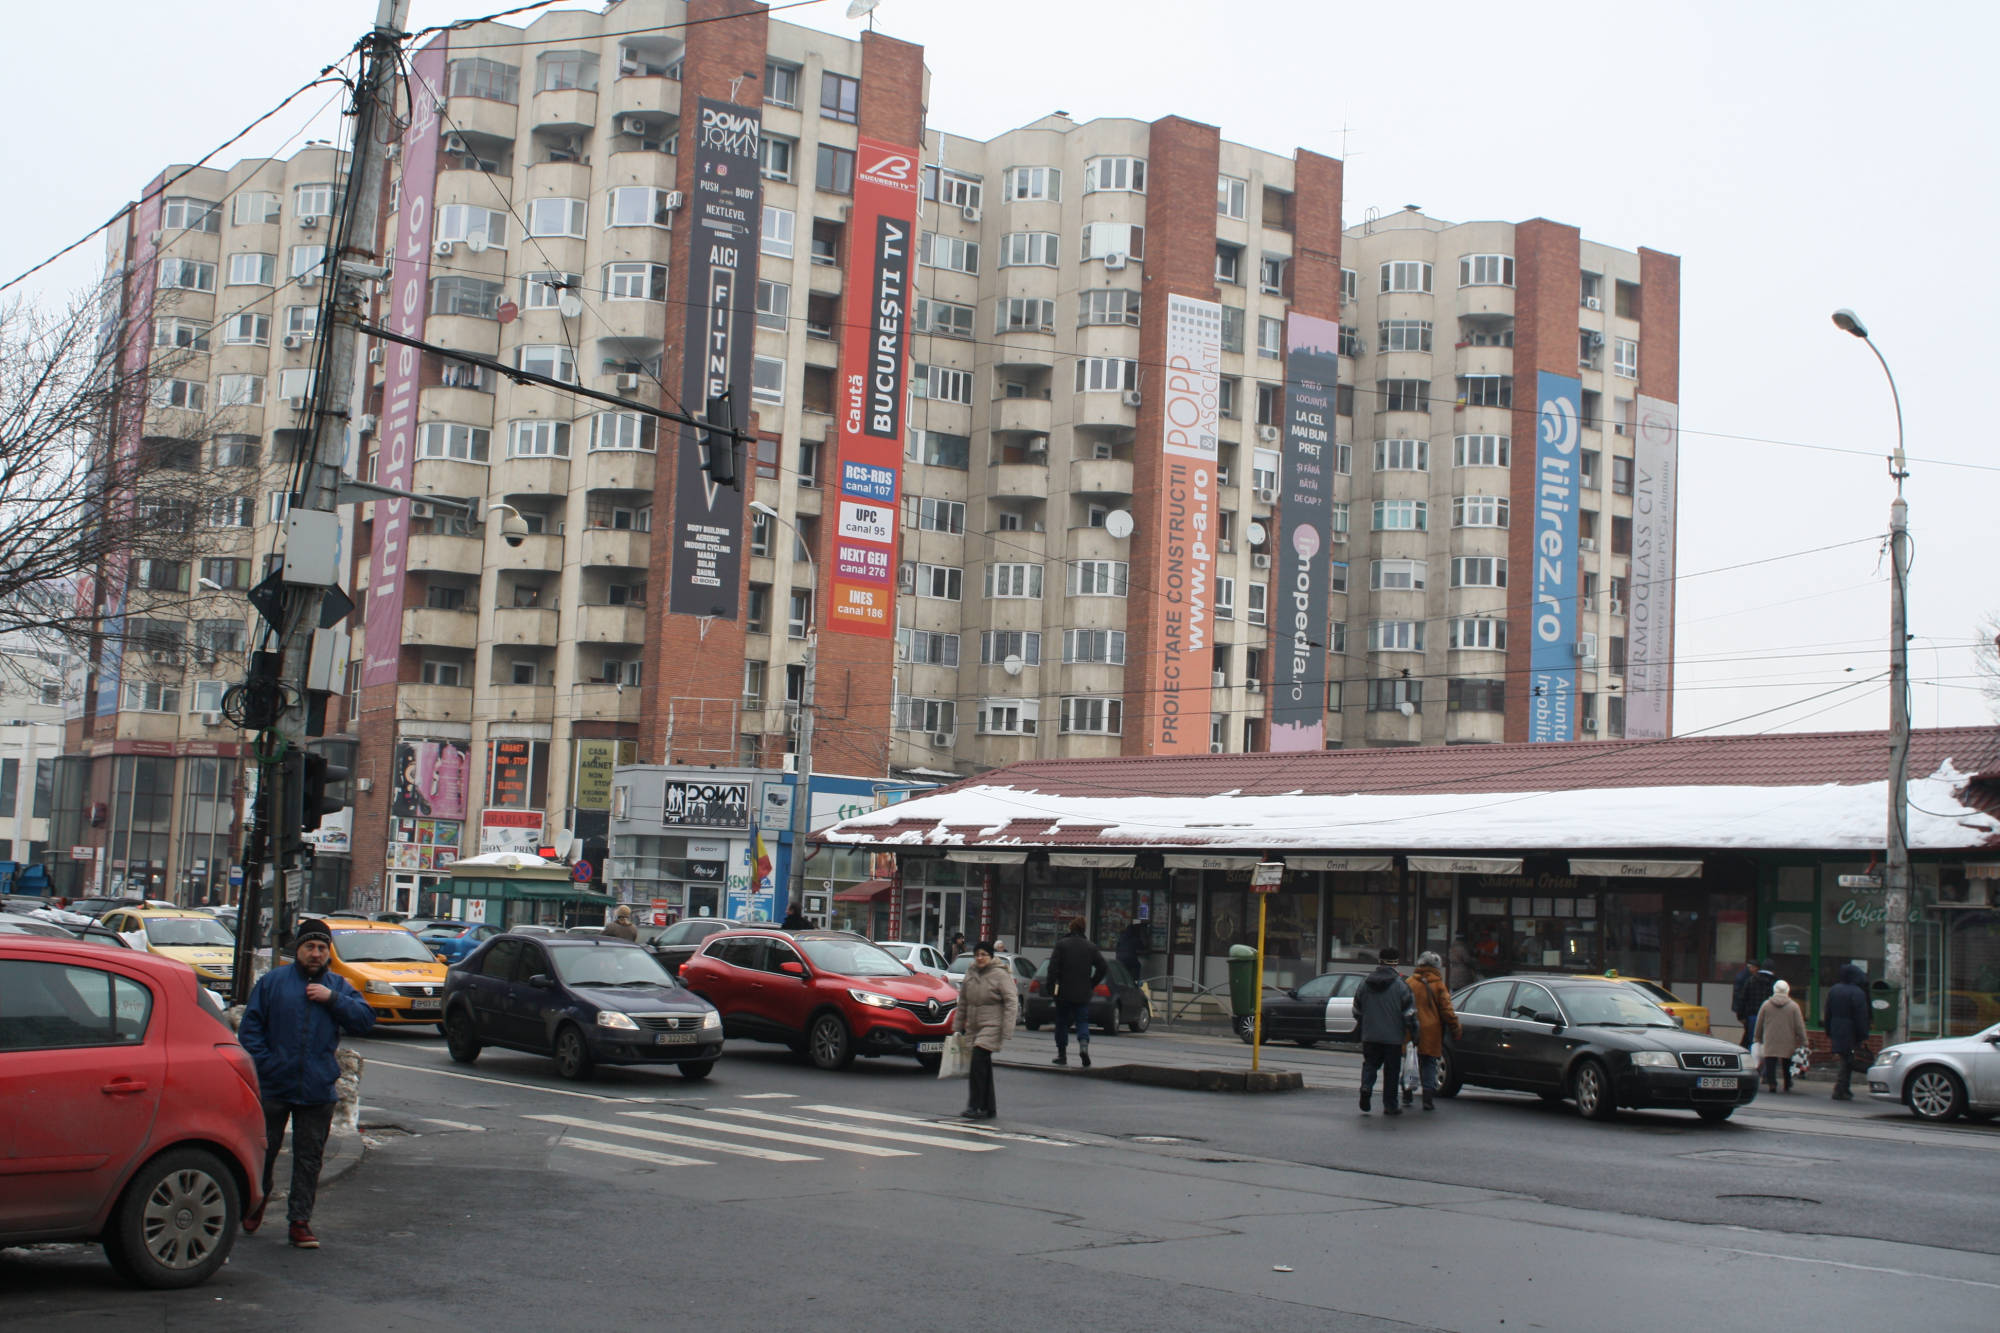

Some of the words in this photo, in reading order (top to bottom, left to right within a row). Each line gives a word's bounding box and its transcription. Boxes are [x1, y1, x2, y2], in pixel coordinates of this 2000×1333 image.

[703, 108, 759, 136] DOWN
[701, 140, 758, 160] FITNESS
[702, 125, 758, 154] TOWN
[700, 179, 719, 193] PUSH
[735, 187, 754, 200] BODY
[884, 222, 903, 260] TV
[709, 245, 739, 268] AICI
[710, 284, 728, 397] FITNE
[846, 374, 863, 434] Caută
[1166, 354, 1200, 449] POPP
[1296, 410, 1308, 423] LA
[1308, 413, 1325, 426] CEL
[1291, 425, 1308, 439] MAI
[1308, 429, 1328, 443] BUN
[1298, 442, 1322, 460] PREȚ
[845, 464, 893, 486] RCS-RDS
[846, 481, 872, 494] canal
[874, 484, 891, 497] 107
[1294, 494, 1303, 503] DE
[1304, 496, 1317, 505] CAP
[1638, 467, 1653, 516] CIV
[856, 508, 877, 524] UPC
[687, 523, 703, 532] BODY
[703, 526, 730, 536] BUILDING
[846, 523, 872, 535] canal
[874, 526, 886, 537] 95
[1166, 464, 1187, 603] CONSTRUCTII
[684, 541, 706, 550] INDOOR
[706, 543, 731, 554] CYCLING
[1538, 456, 1570, 643] titirez.ro
[1658, 529, 1667, 554] PVC
[839, 546, 866, 563] NEXT
[867, 550, 888, 567] GEN
[1189, 468, 1211, 652] www.p-a.ro
[840, 563, 866, 575] canal
[868, 567, 886, 578] 276
[849, 589, 873, 606] INES
[837, 604, 864, 616] canal
[1631, 525, 1652, 696] TERMOGLASS
[1162, 609, 1182, 744] PROIECTARE
[1535, 674, 1552, 743] Imobilia
[1554, 675, 1571, 742] Anunțu
[588, 748, 608, 756] CASA
[687, 785, 747, 802] DOWN
[1619, 864, 1647, 876] Orient
